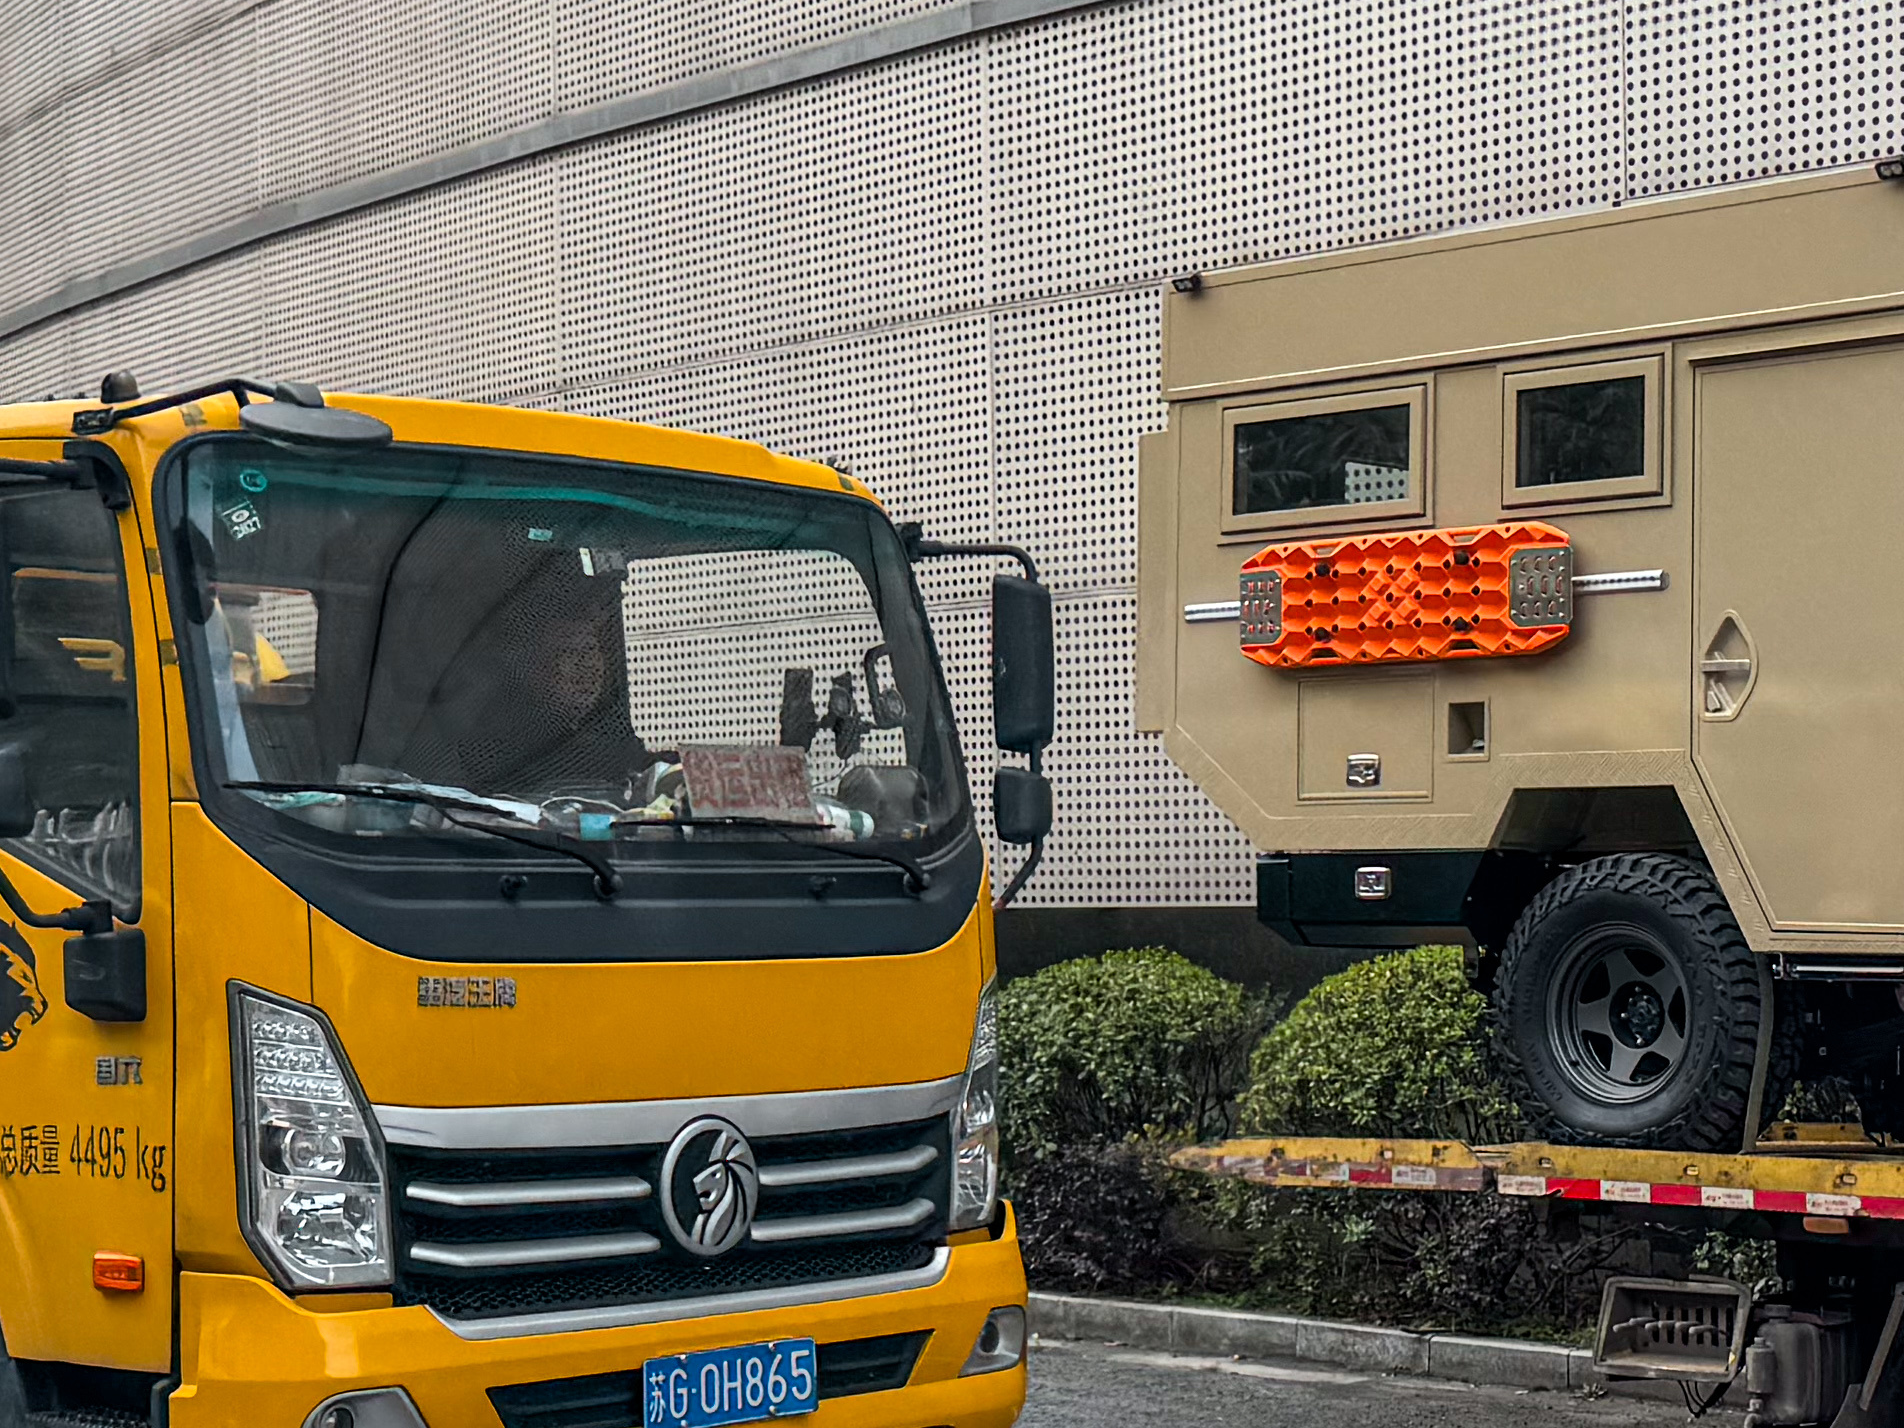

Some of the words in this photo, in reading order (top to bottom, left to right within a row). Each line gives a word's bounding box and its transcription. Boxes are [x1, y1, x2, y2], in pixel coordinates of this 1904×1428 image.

[0, 1124, 61, 1180] 总质量
[69, 1122, 126, 1180] 4495
[136, 1125, 167, 1193] kg
